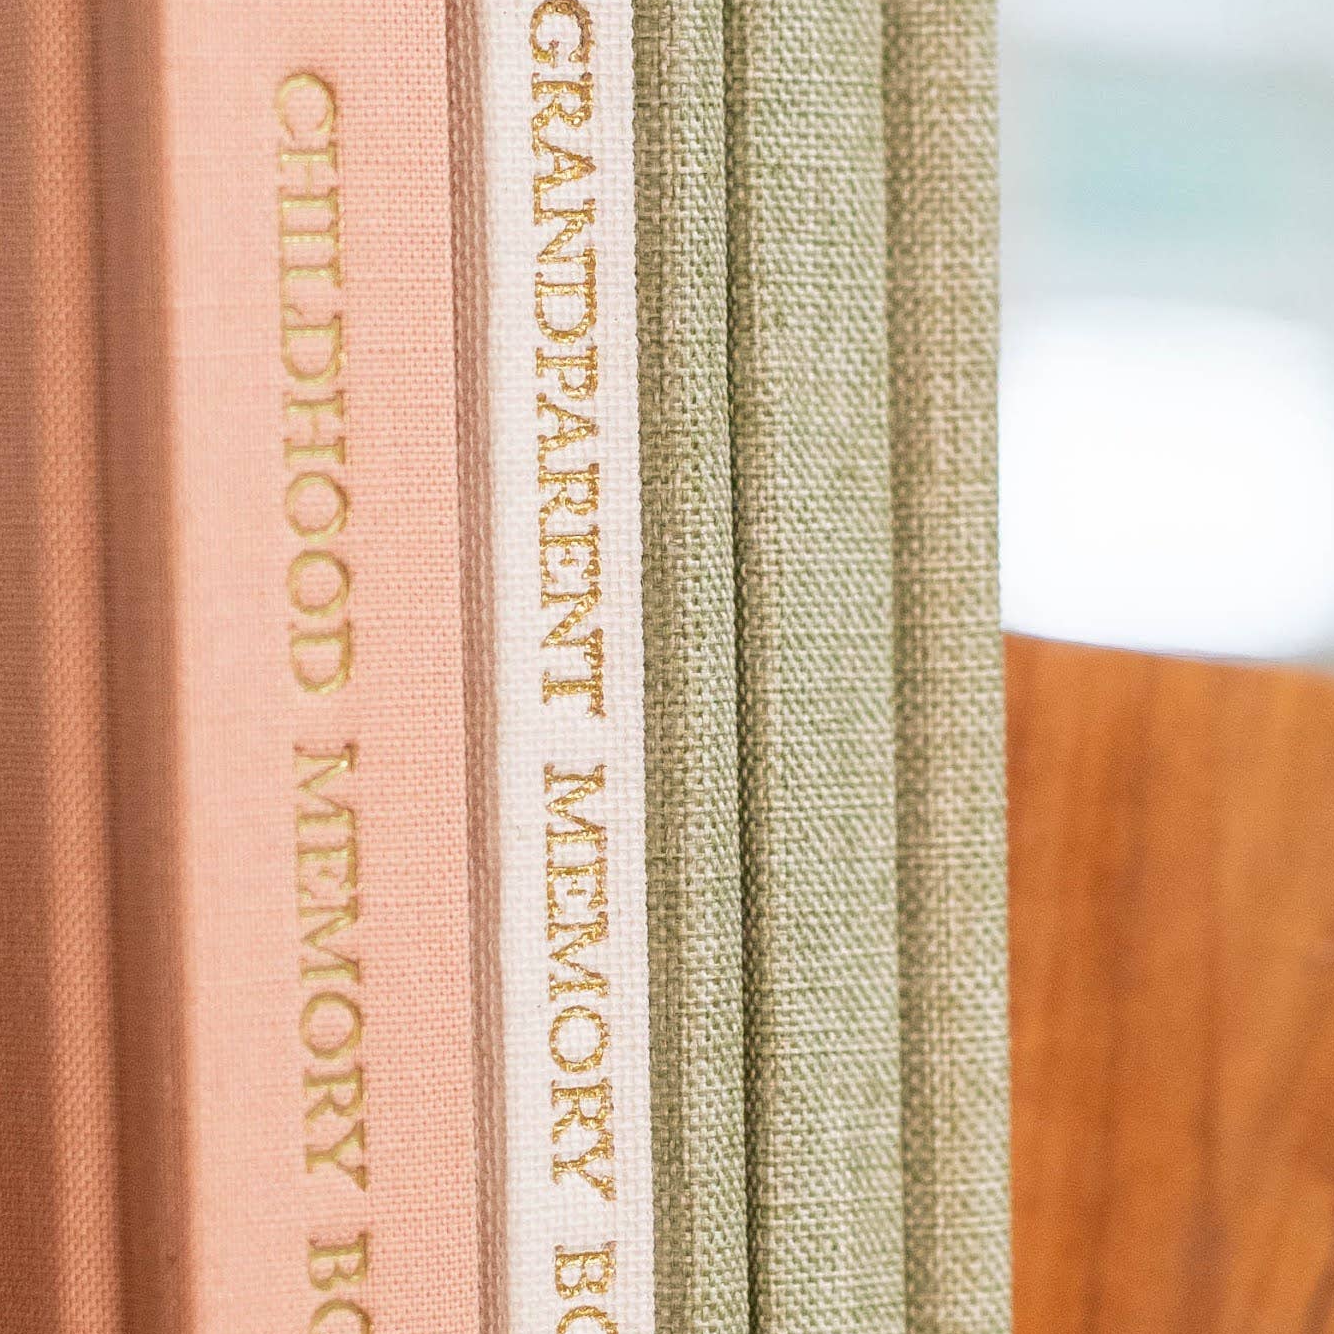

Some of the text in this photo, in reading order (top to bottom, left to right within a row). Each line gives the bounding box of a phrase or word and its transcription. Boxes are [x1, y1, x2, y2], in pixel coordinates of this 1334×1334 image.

[276, 72, 355, 695] CHILDHOOD
[294, 742, 368, 1193] MEMORY
[543, 762, 618, 1202] MEMORY
